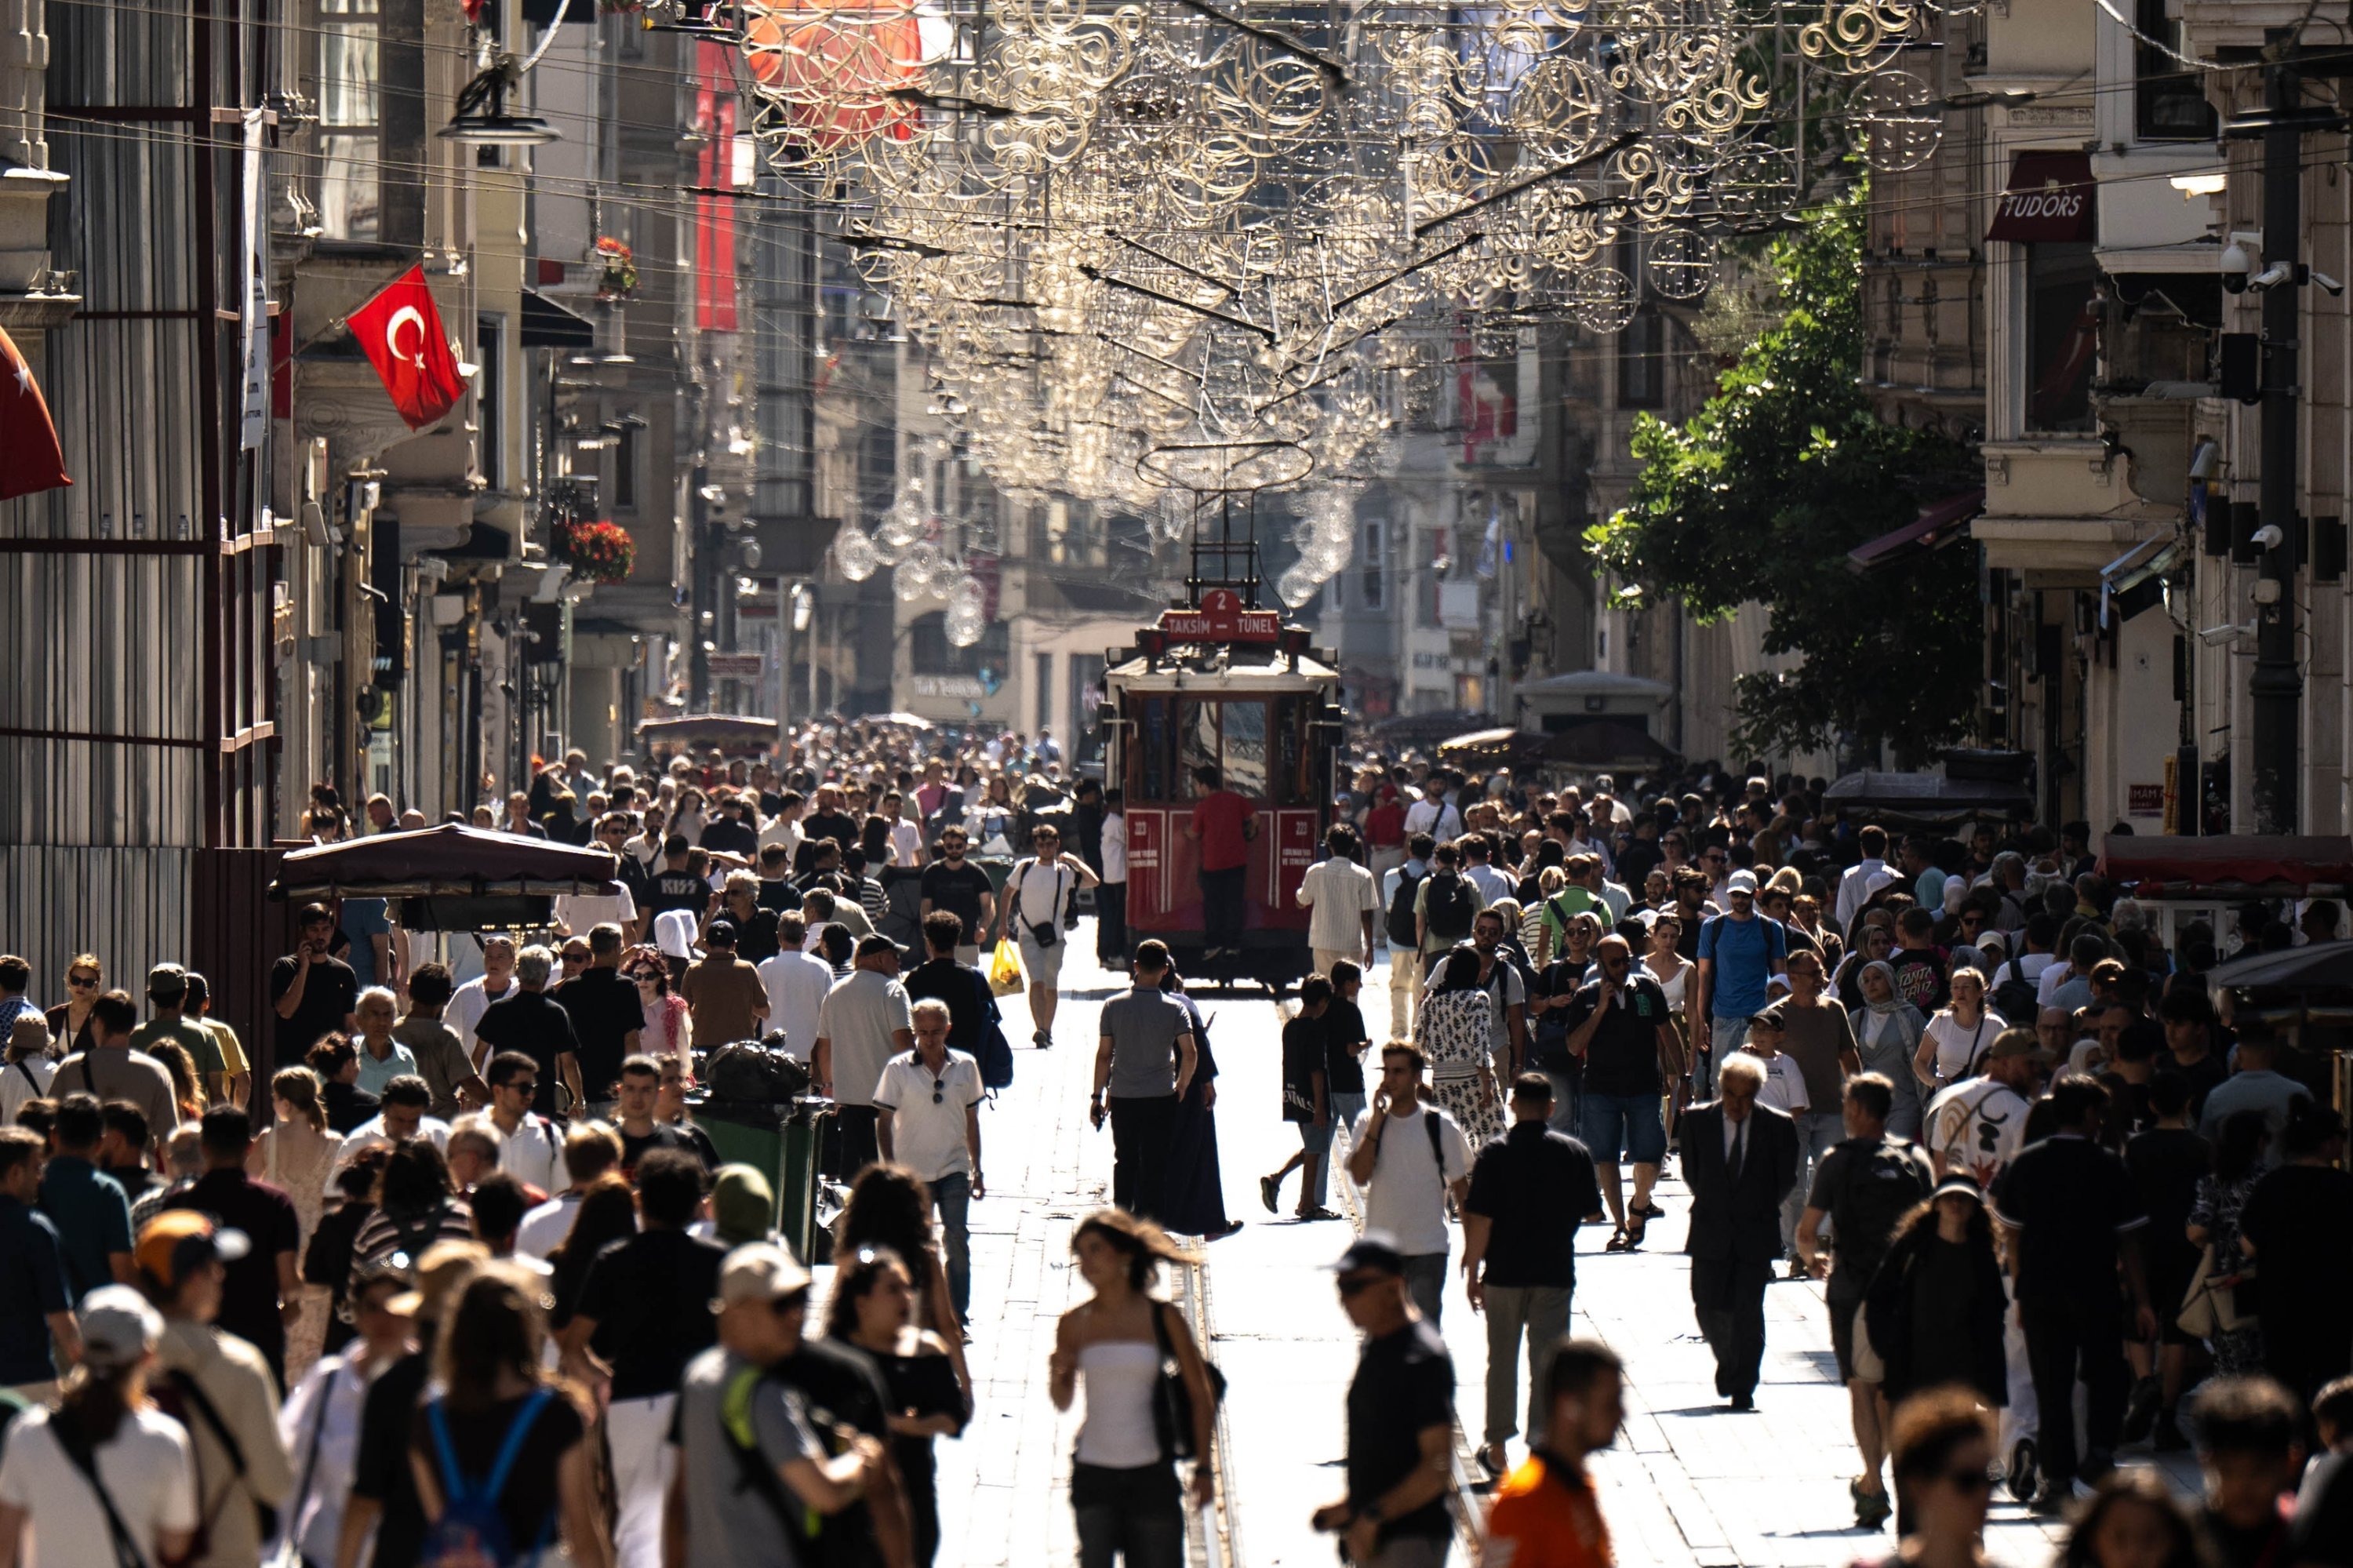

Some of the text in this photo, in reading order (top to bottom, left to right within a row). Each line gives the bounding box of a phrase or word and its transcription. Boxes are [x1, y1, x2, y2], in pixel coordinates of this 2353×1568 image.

[2006, 194, 2082, 217] TUDORS
[1217, 591, 1226, 610] 2
[1169, 616, 1210, 634] TAKSİM
[1237, 613, 1274, 633] TÜNEL
[660, 879, 697, 894] KISS
